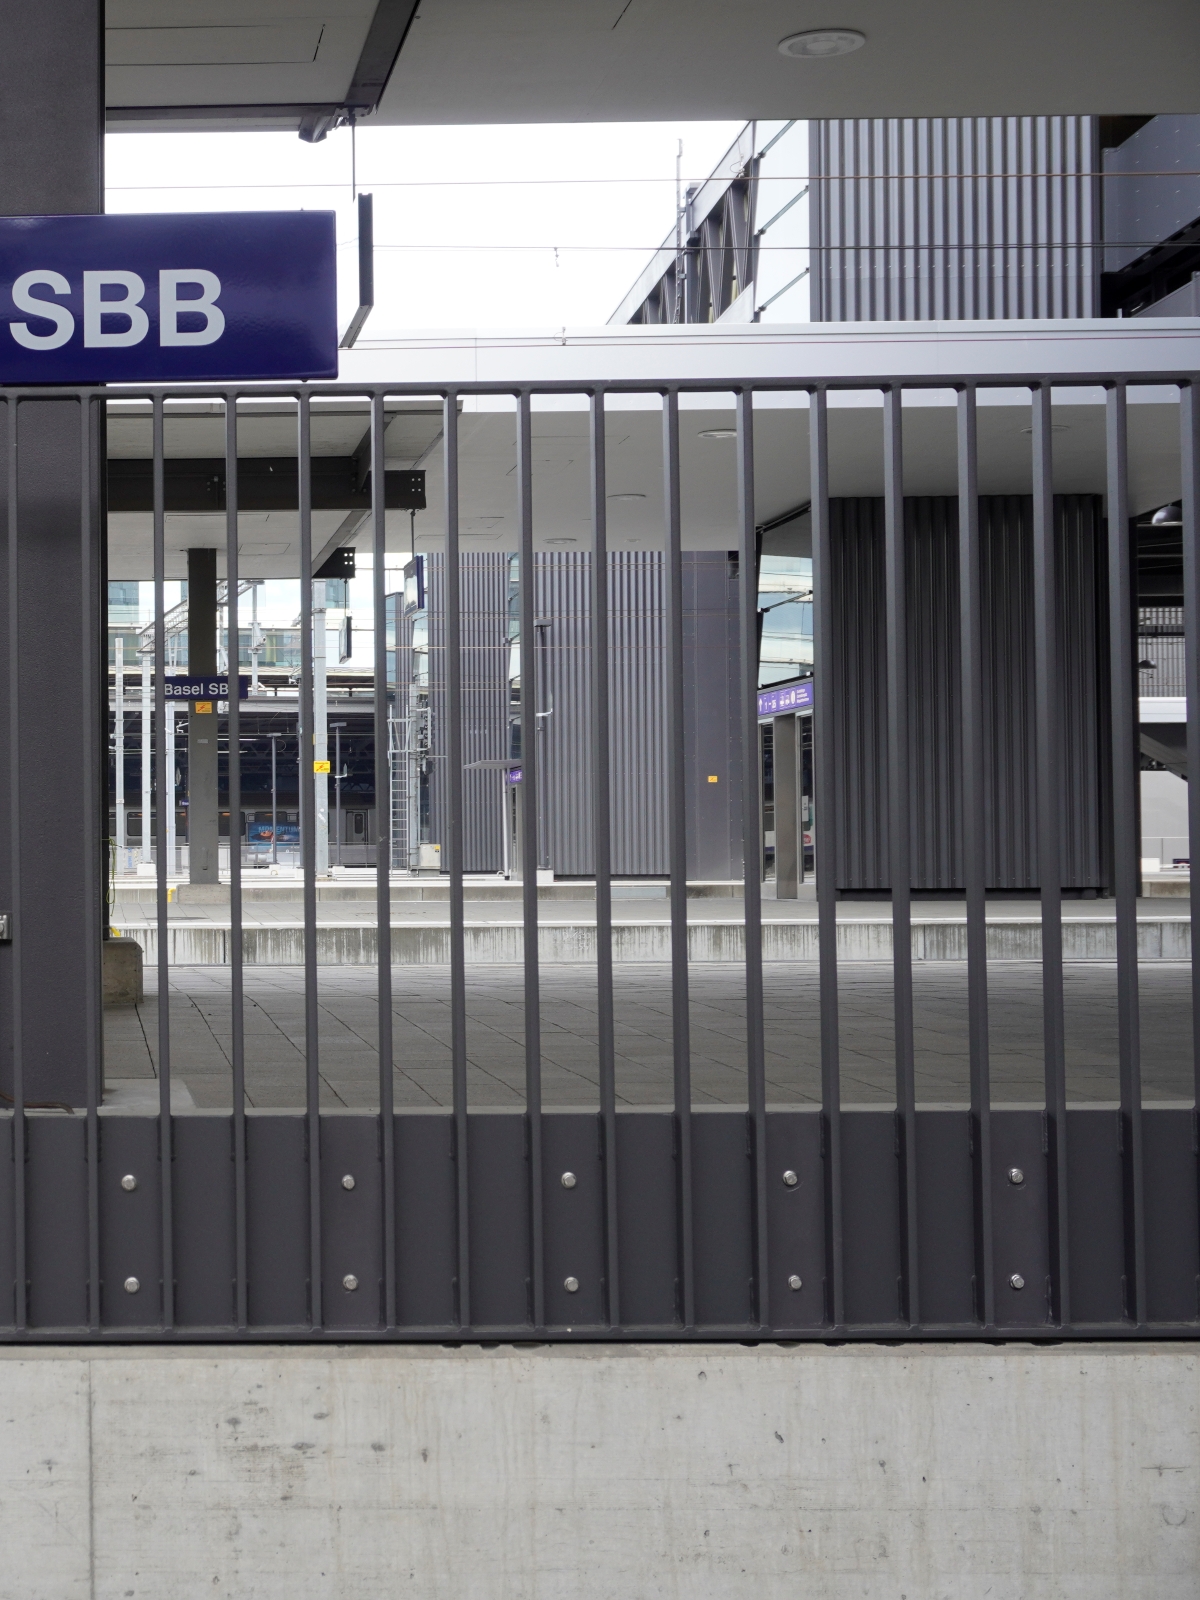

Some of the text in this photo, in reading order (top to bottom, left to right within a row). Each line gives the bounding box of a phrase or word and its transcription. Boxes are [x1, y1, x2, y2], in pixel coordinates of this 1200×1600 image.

[8, 268, 226, 351] SBB
[165, 683, 229, 695] Basel SB
